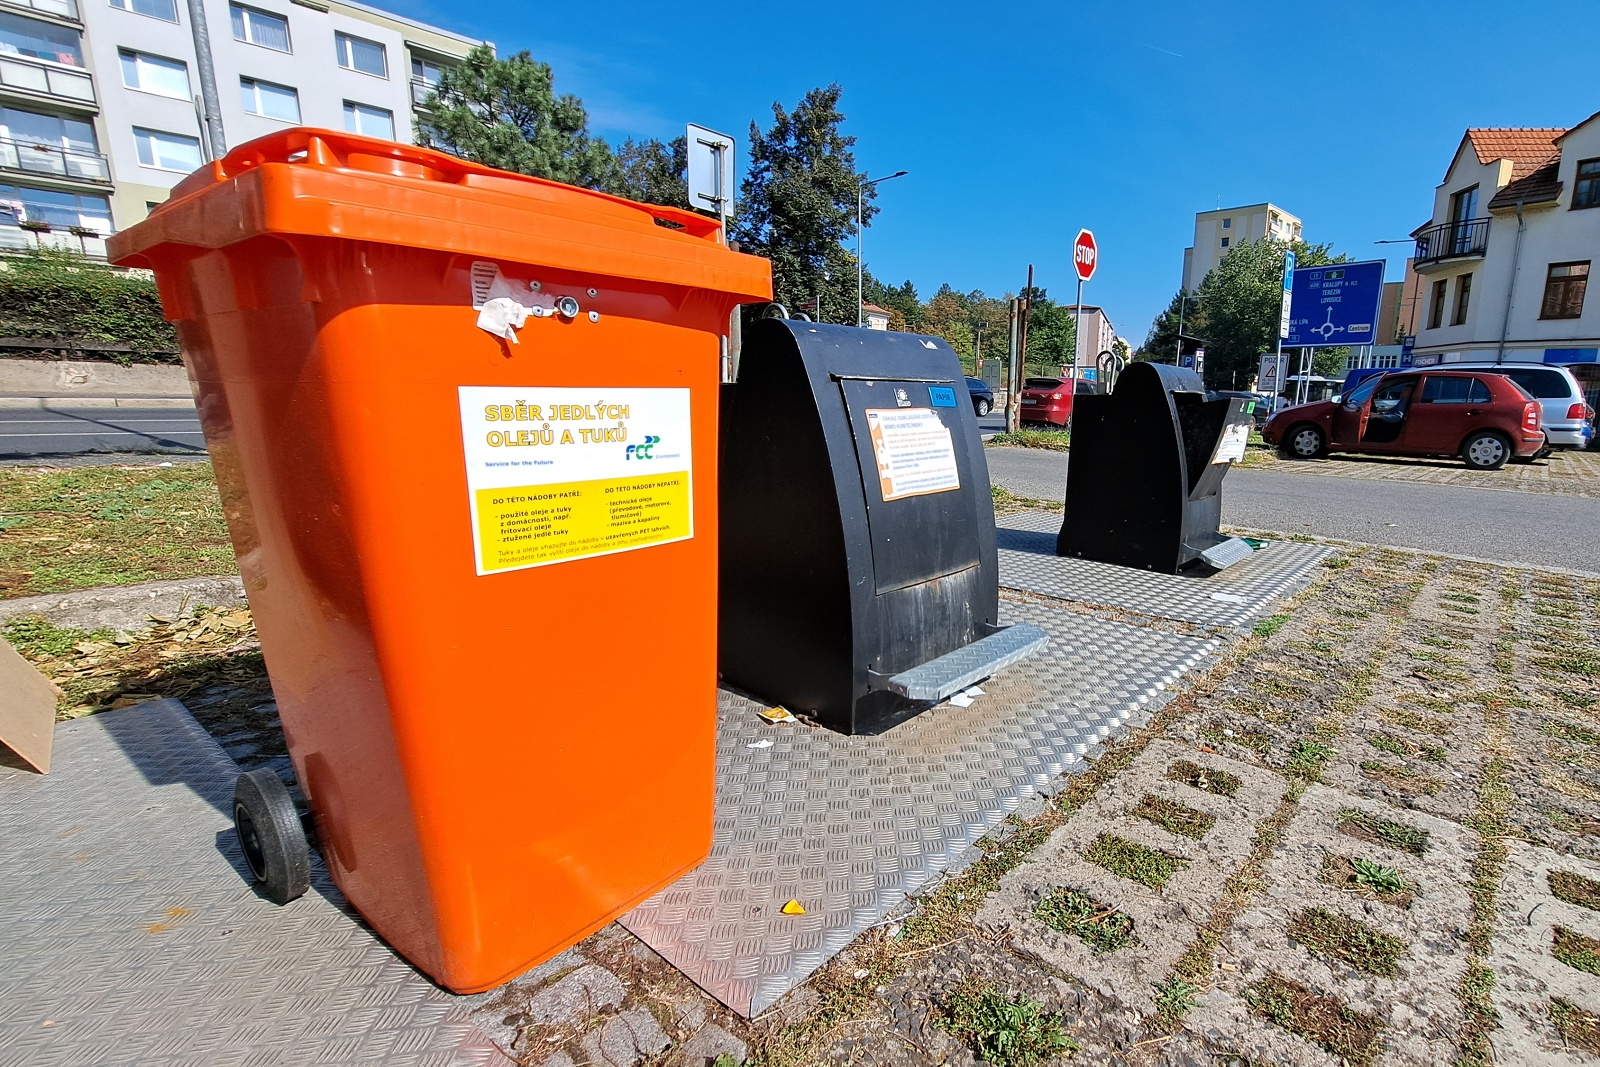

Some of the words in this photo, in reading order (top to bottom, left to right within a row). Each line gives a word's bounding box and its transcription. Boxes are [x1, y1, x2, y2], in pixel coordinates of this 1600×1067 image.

[1077, 244, 1094, 265] STOP
[1287, 256, 1292, 277] P
[1185, 357, 1191, 365] P
[935, 392, 951, 400] PAPÍR
[485, 400, 544, 421] SBĚR
[549, 400, 629, 420] JEDLÝCH
[486, 423, 554, 447] OLEJŮ
[560, 429, 574, 444] A
[579, 421, 627, 444] TUKŮ
[626, 444, 653, 460] FCC
[500, 510, 528, 520] použité
[531, 508, 548, 517] oleje
[610, 505, 643, 514] (převodové,
[612, 512, 642, 520] tlumičové)
[501, 525, 532, 534] fritovací
[502, 534, 532, 542] ztužené
[534, 531, 551, 539] jedlé
[541, 542, 567, 550] vhazujte
[606, 530, 638, 540] uzavřených
[499, 554, 534, 563] Předejdete
[590, 541, 610, 549] nádoby
